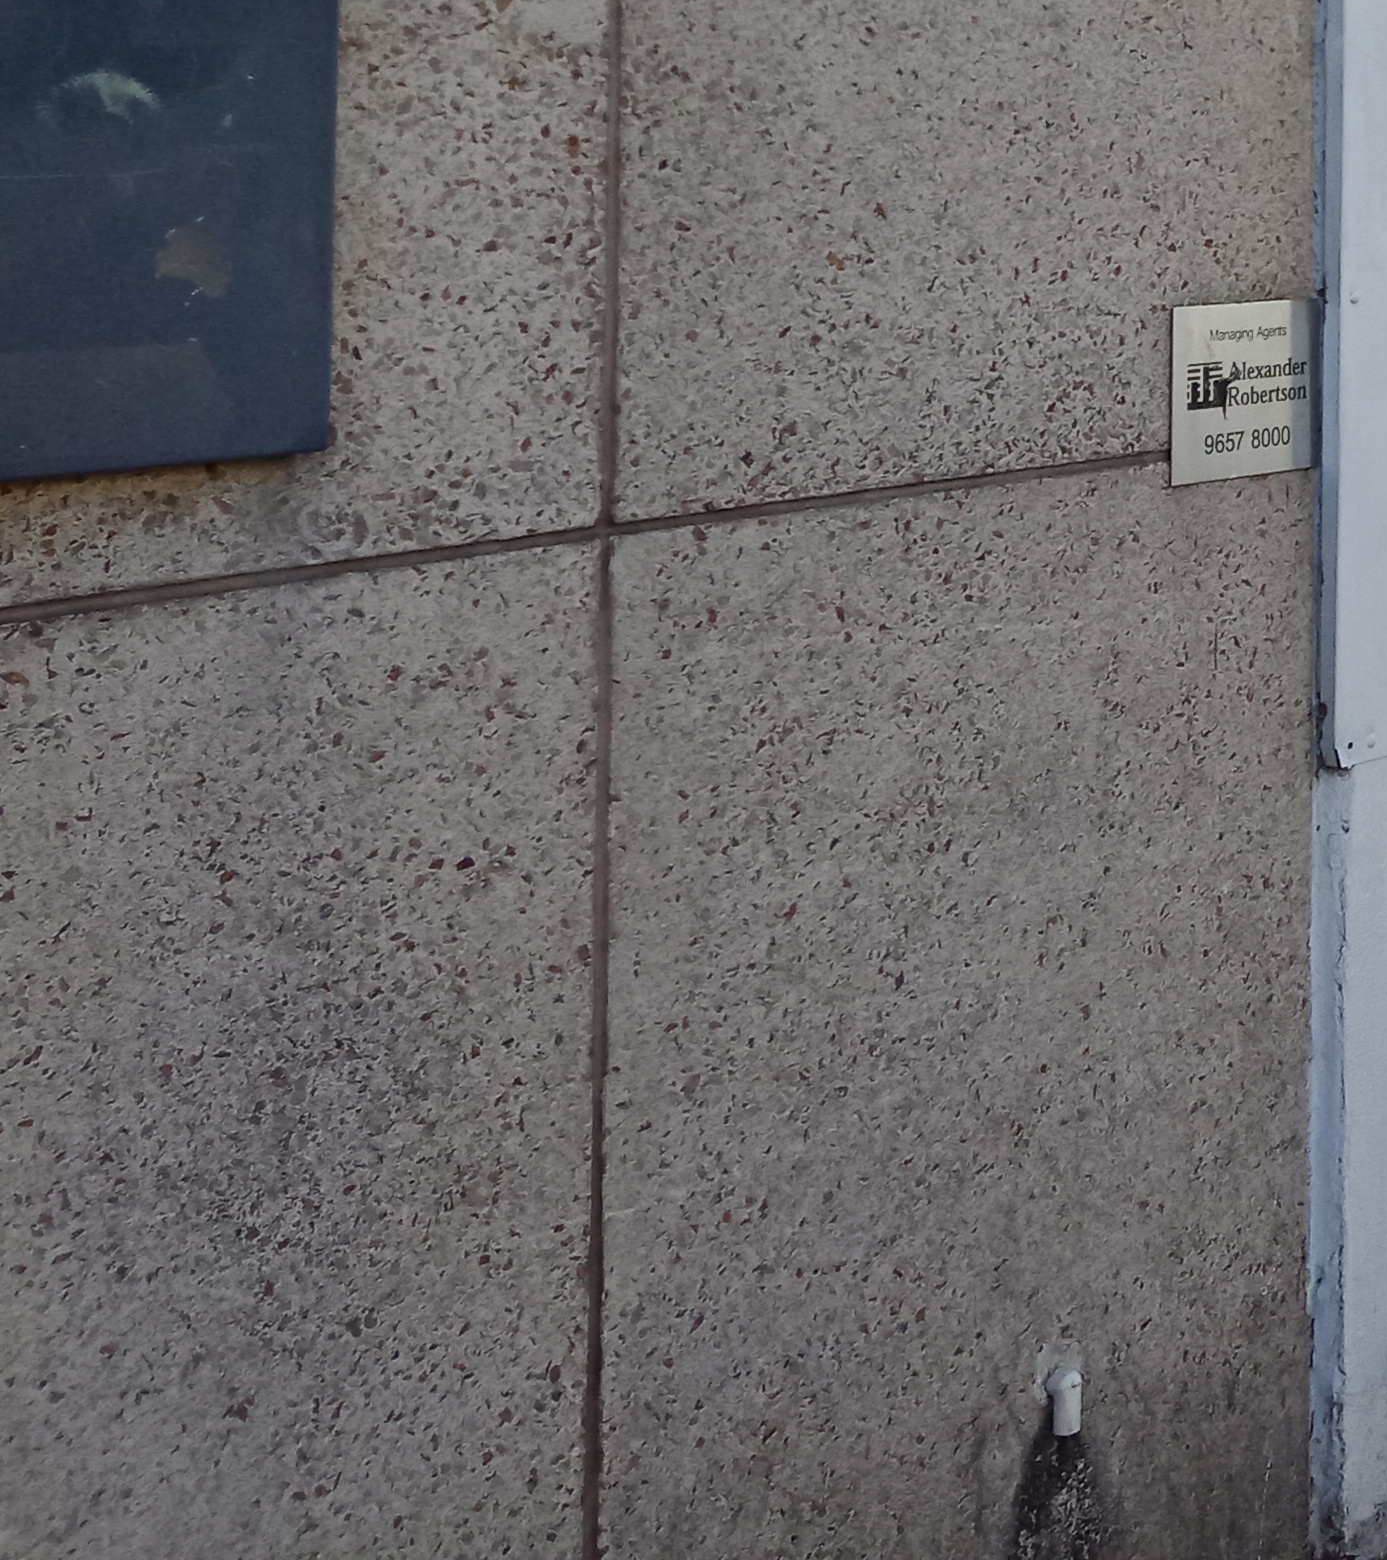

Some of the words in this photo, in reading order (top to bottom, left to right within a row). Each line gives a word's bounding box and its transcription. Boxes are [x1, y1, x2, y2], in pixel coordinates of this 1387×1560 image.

[1209, 329, 1254, 343] Managing
[1256, 326, 1288, 341] Agents
[1228, 358, 1307, 381] Alexander
[1227, 384, 1307, 407] Robertson
[1204, 430, 1245, 455] 9657
[1251, 425, 1291, 450] 8000
